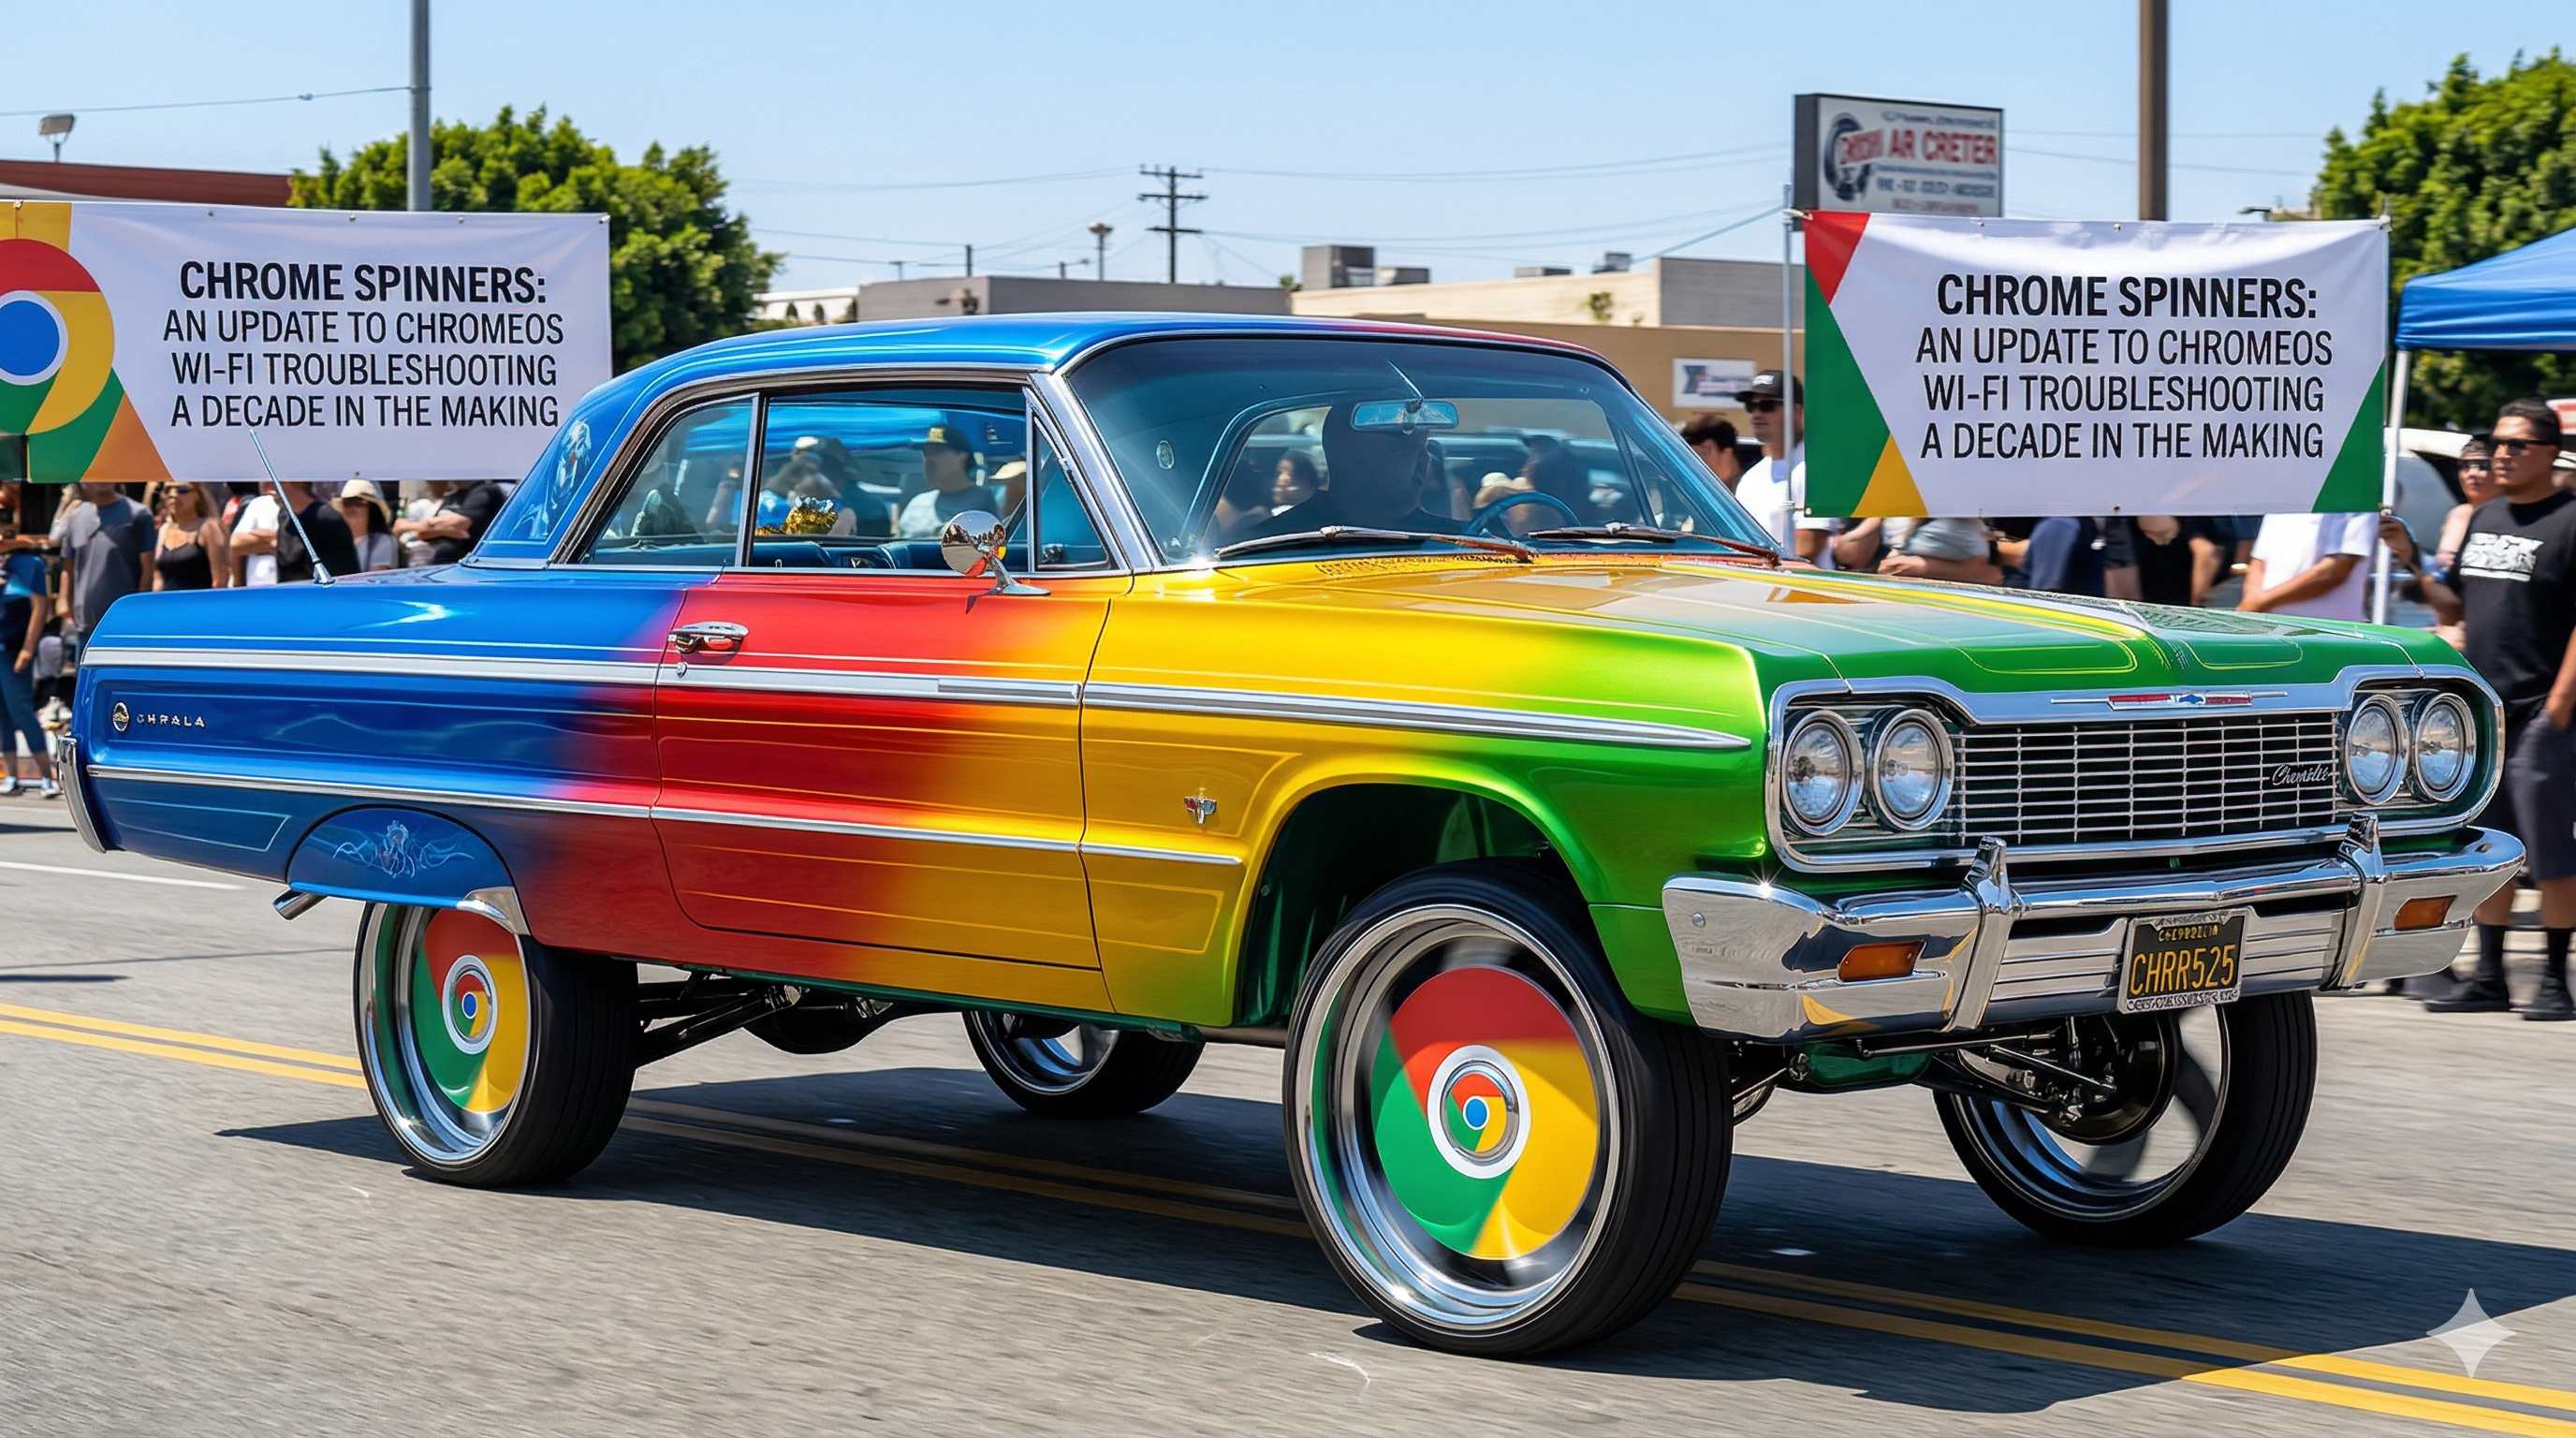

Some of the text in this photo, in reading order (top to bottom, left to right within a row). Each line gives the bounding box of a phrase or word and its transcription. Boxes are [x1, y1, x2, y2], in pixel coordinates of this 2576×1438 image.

[180, 260, 547, 305] CHROME SPINNERS:
[1937, 273, 2318, 319] CHROME SPINNERS:
[163, 309, 564, 345] AN UPDATE TO CHROMEOS
[1915, 327, 2334, 366] AN UPDATE TO CHROMEOS
[170, 351, 557, 387] WI-FI TROUBLESHOOTING
[170, 394, 559, 428] A DECADE IN THE MAKING
[1923, 374, 2324, 413] WI-FI TROUBLESHOOTING
[1920, 422, 2323, 460] A DECADE IN THE MAKING
[2130, 944, 2237, 996] CHRR525
